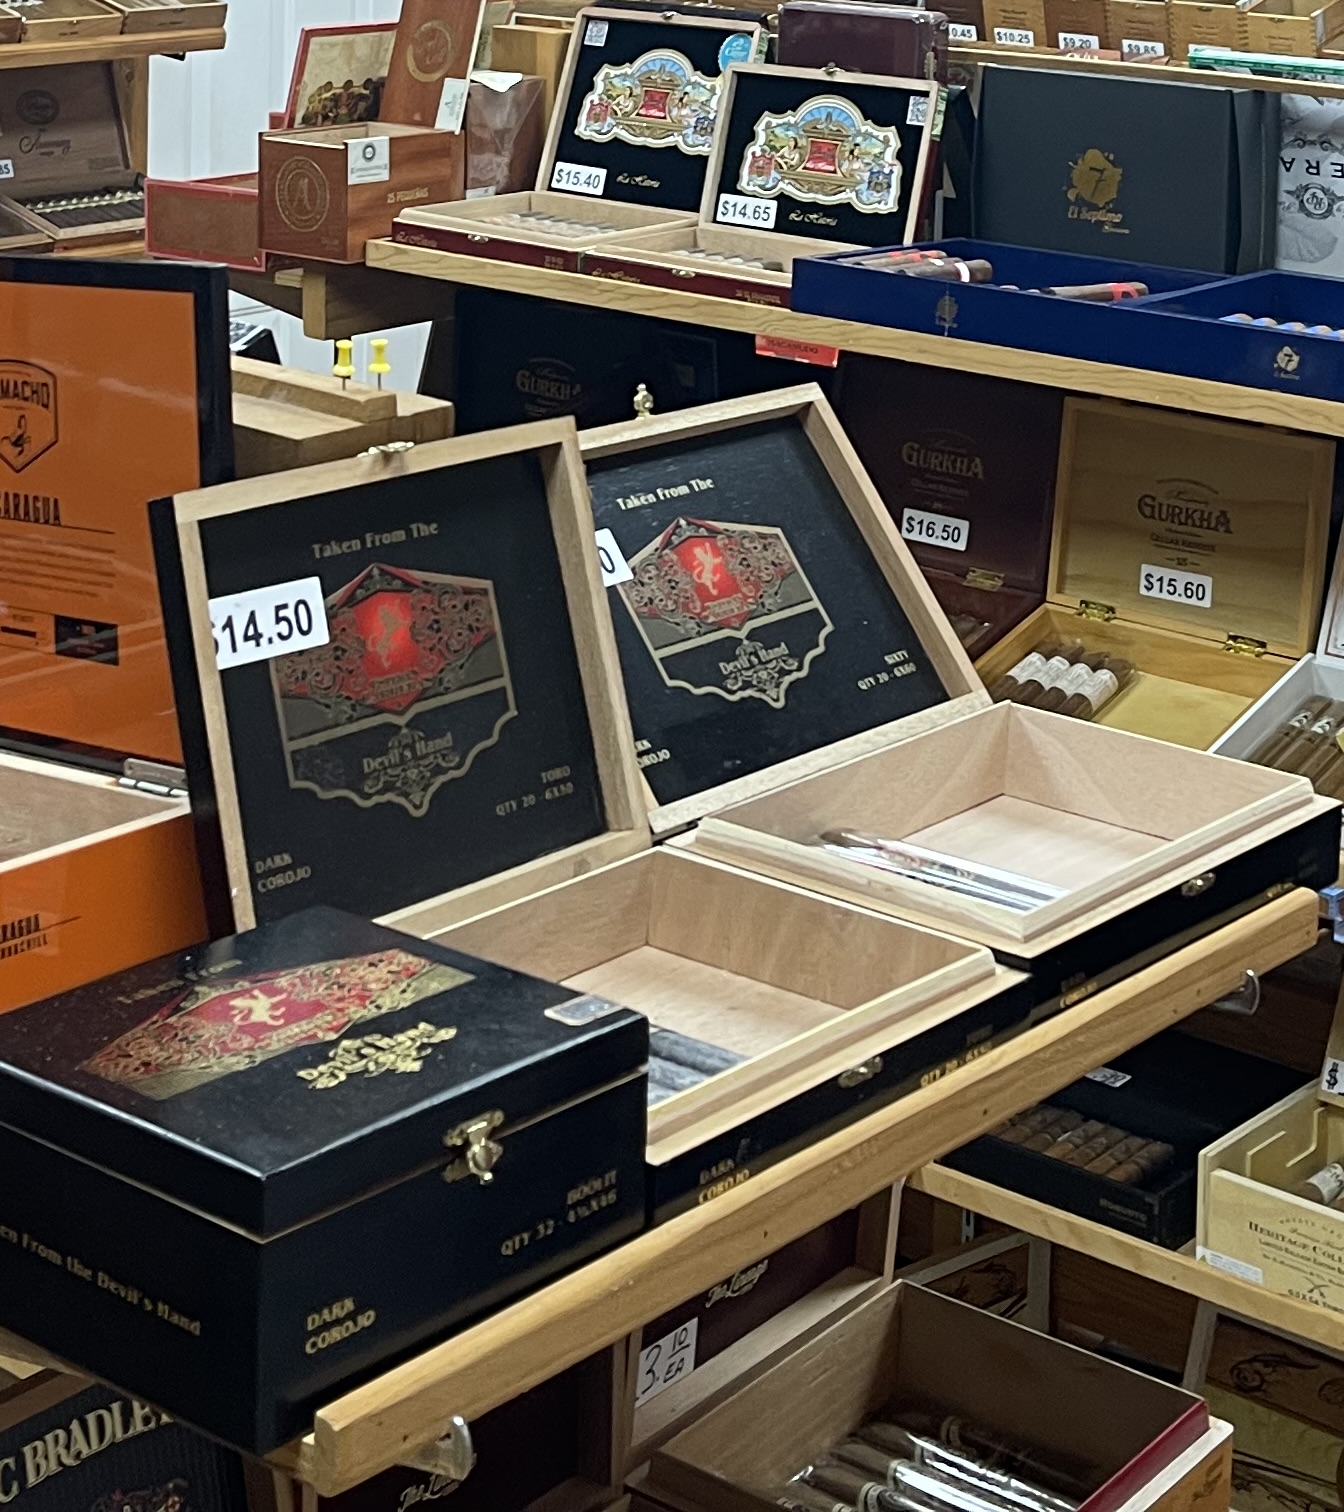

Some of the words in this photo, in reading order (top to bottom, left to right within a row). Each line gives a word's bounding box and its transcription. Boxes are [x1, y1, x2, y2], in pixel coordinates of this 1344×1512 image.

[996, 31, 1031, 44] $10.25
[1063, 37, 1092, 48] $9.20
[555, 167, 601, 191] $15.40
[722, 199, 773, 222] $14.65
[901, 441, 985, 480] GURKHA
[616, 491, 657, 513] Taken
[657, 481, 691, 504] From
[692, 476, 715, 492] The
[1138, 494, 1233, 534] GURKHA
[311, 538, 362, 560] Taken
[365, 527, 406, 549] From
[409, 521, 439, 539] The
[905, 516, 962, 545] $16.50
[1143, 570, 1207, 602] $15.60
[719, 650, 759, 676] Devil's
[363, 739, 414, 775] Devil's
[256, 852, 294, 874] DARK
[257, 865, 313, 893] COROJO
[21, 1232, 63, 1266] From
[66, 1255, 94, 1282] the
[97, 1272, 154, 1312] Devil's
[157, 1299, 202, 1337] Hand
[306, 1296, 355, 1332] DARK
[305, 1309, 377, 1357] COROJO
